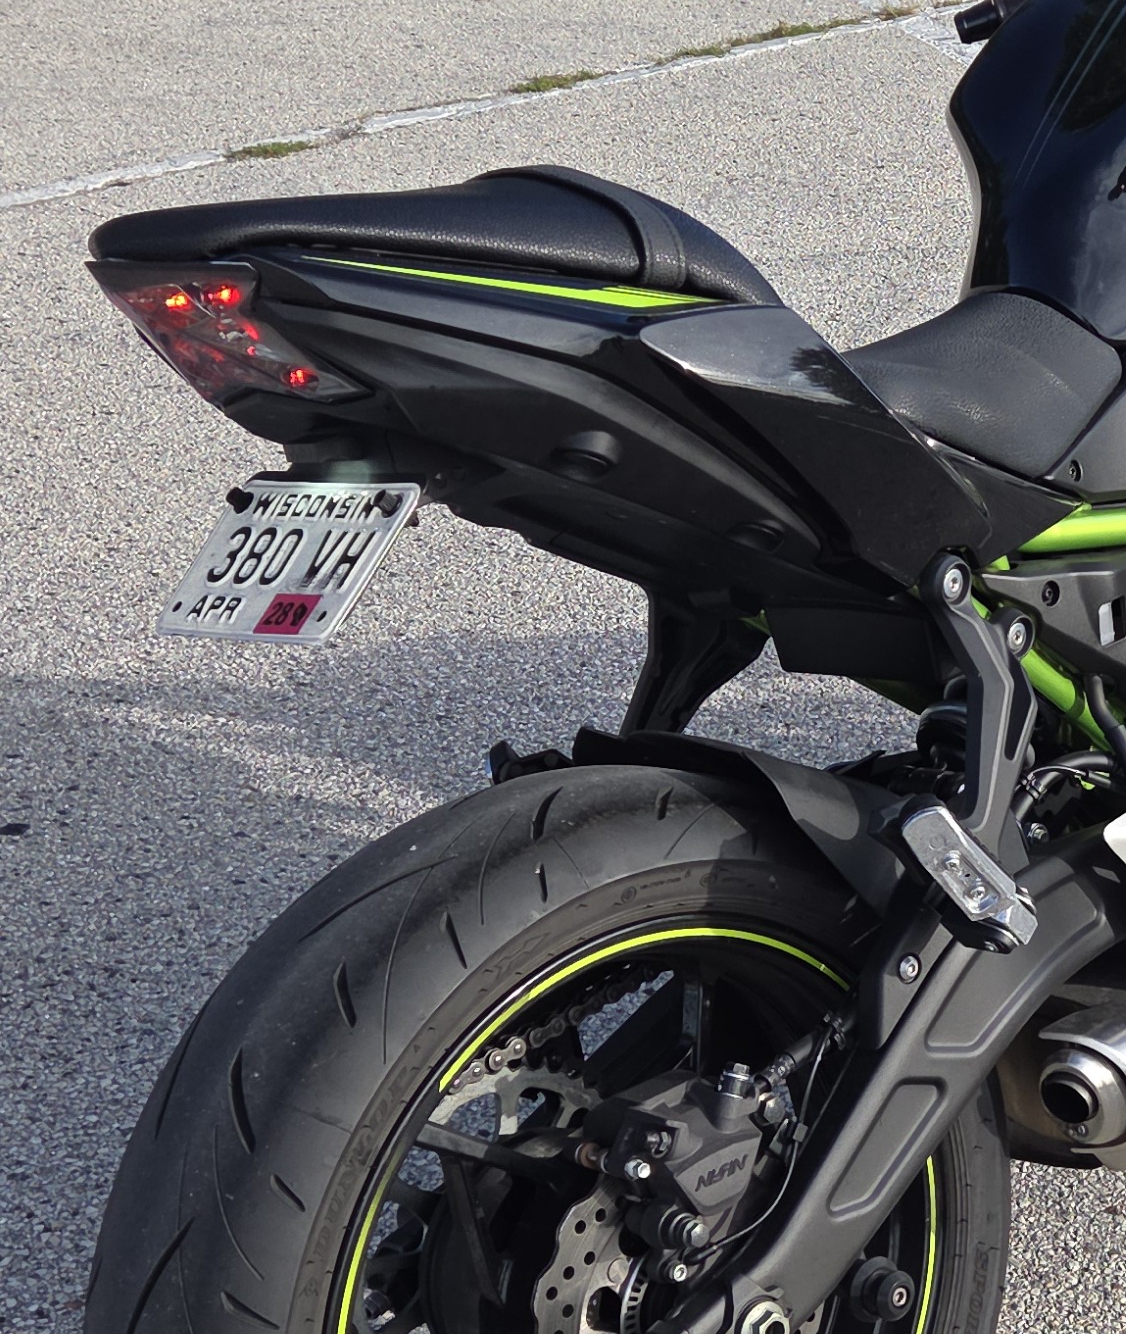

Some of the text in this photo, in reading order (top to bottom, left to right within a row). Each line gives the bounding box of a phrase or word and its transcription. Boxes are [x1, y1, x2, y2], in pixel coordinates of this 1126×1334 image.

[253, 492, 374, 519] WISCONSIN
[207, 527, 375, 589] 380 VH
[187, 595, 242, 619] APR
[262, 601, 295, 626] 28
